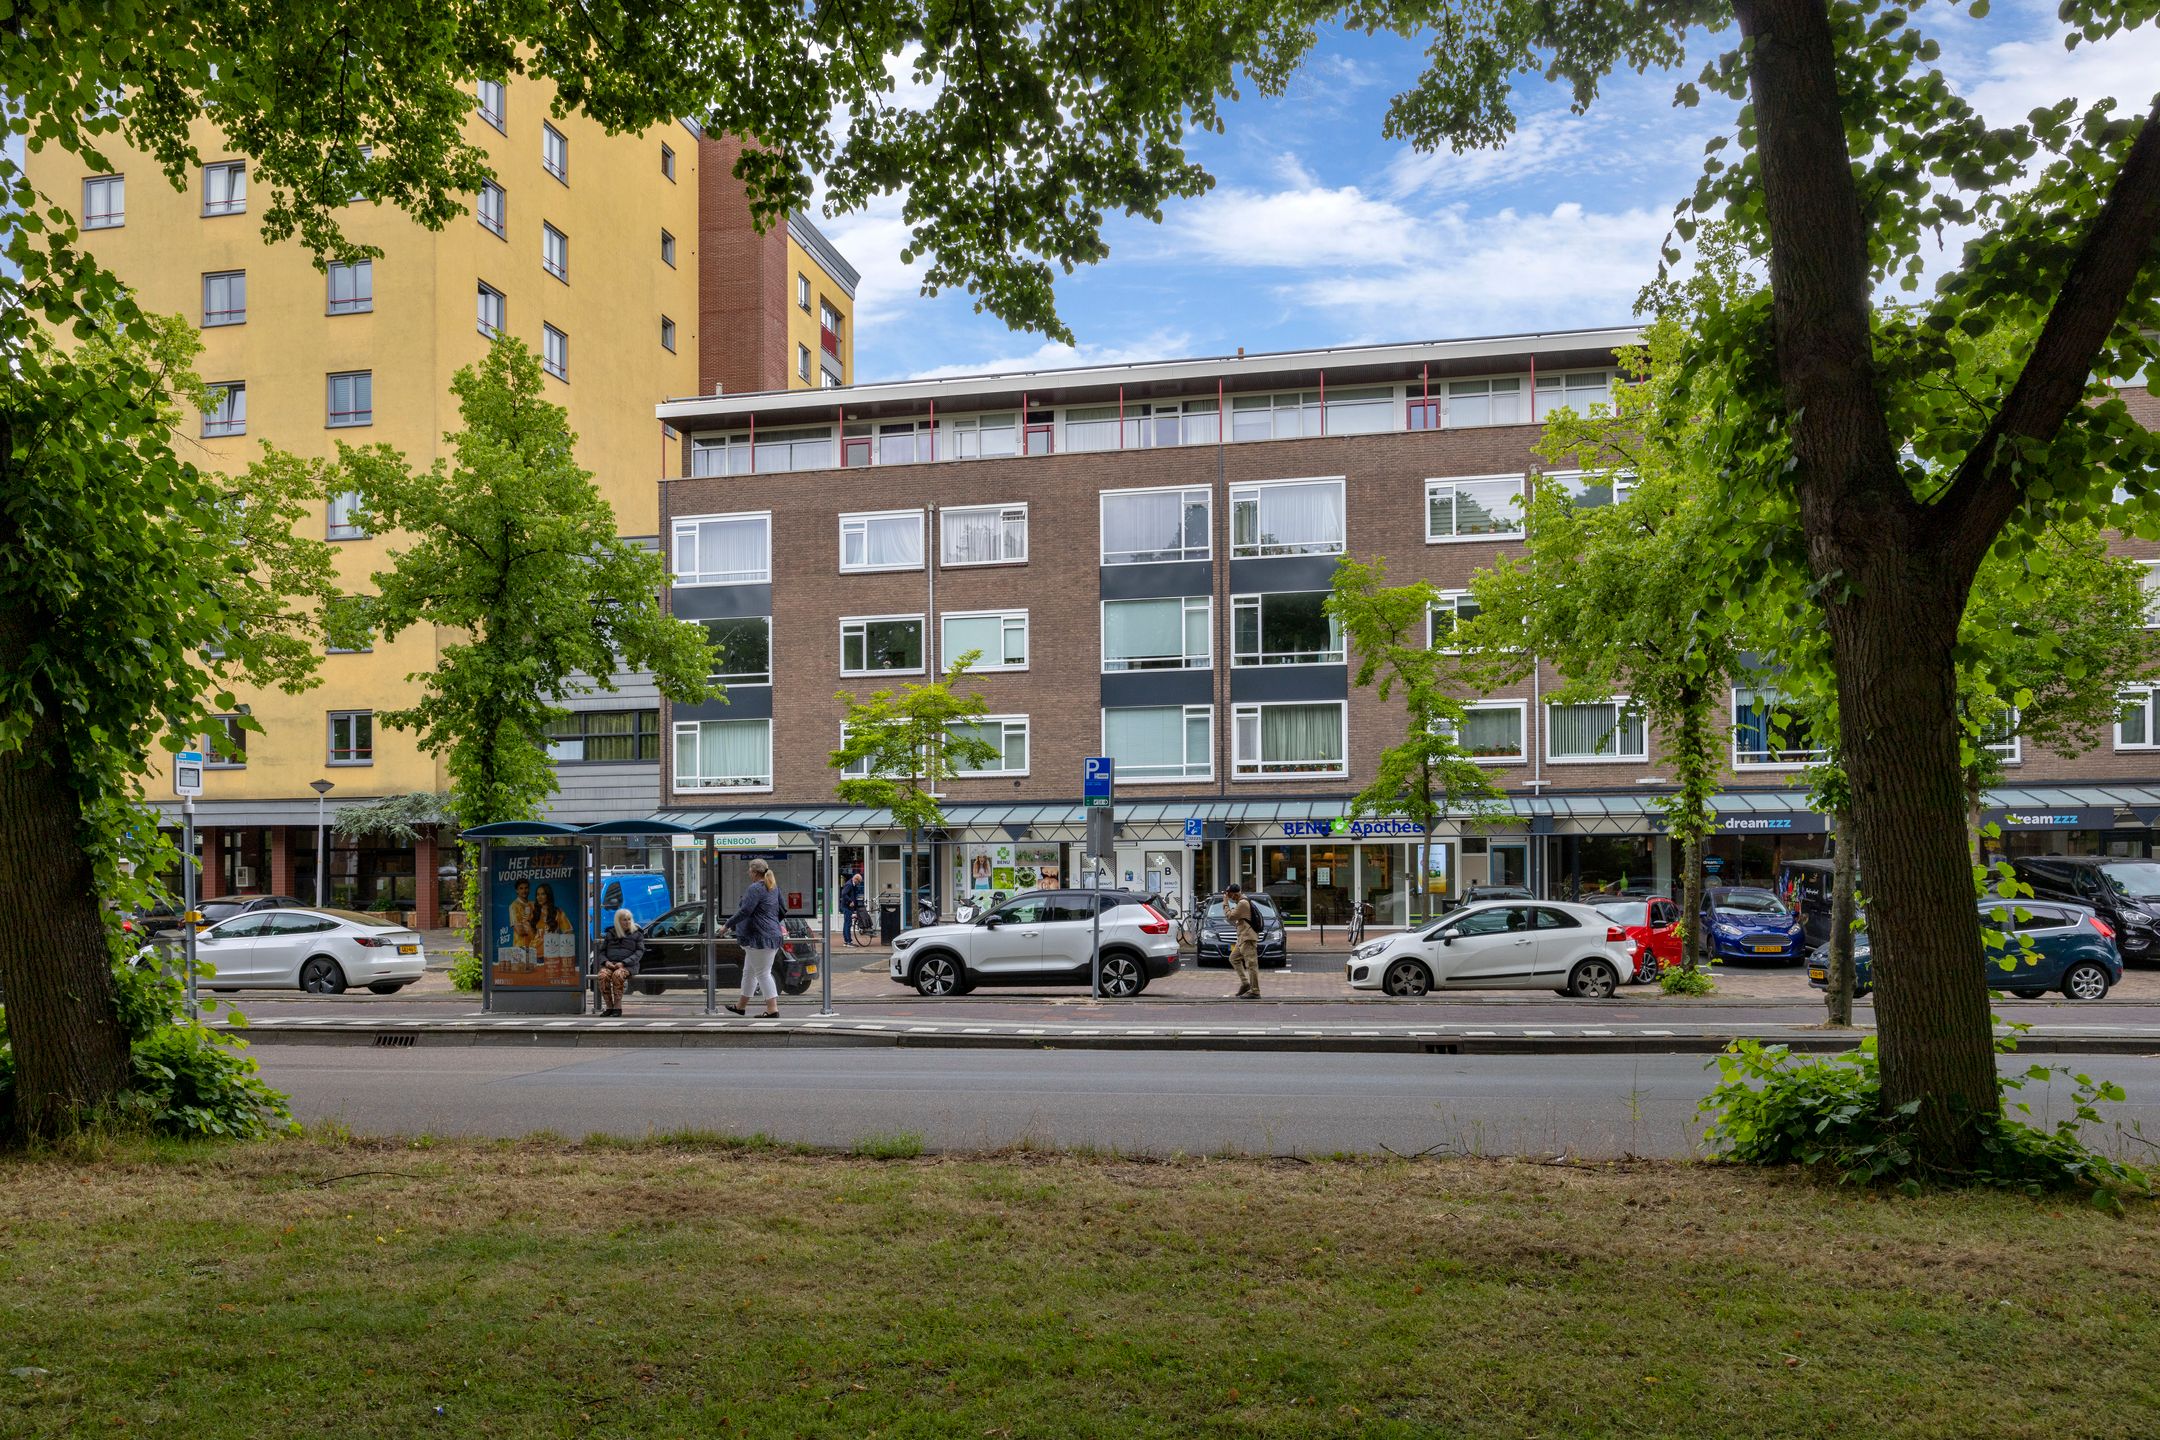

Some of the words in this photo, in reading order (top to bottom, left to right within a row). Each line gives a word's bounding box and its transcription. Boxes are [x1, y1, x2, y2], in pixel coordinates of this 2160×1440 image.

[1086, 759, 1100, 780] P
[1725, 818, 1791, 829] dreamzzz
[2007, 813, 2078, 825] dreamzzz
[1187, 820, 1196, 832] P
[1284, 821, 1330, 835] BENU
[1351, 820, 1423, 837] Apothee
[714, 837, 757, 846] GENBOOG
[508, 856, 530, 870] HET
[498, 867, 574, 882] VOORSPELSHIRT
[1099, 867, 1106, 876] A
[1164, 866, 1172, 876] B
